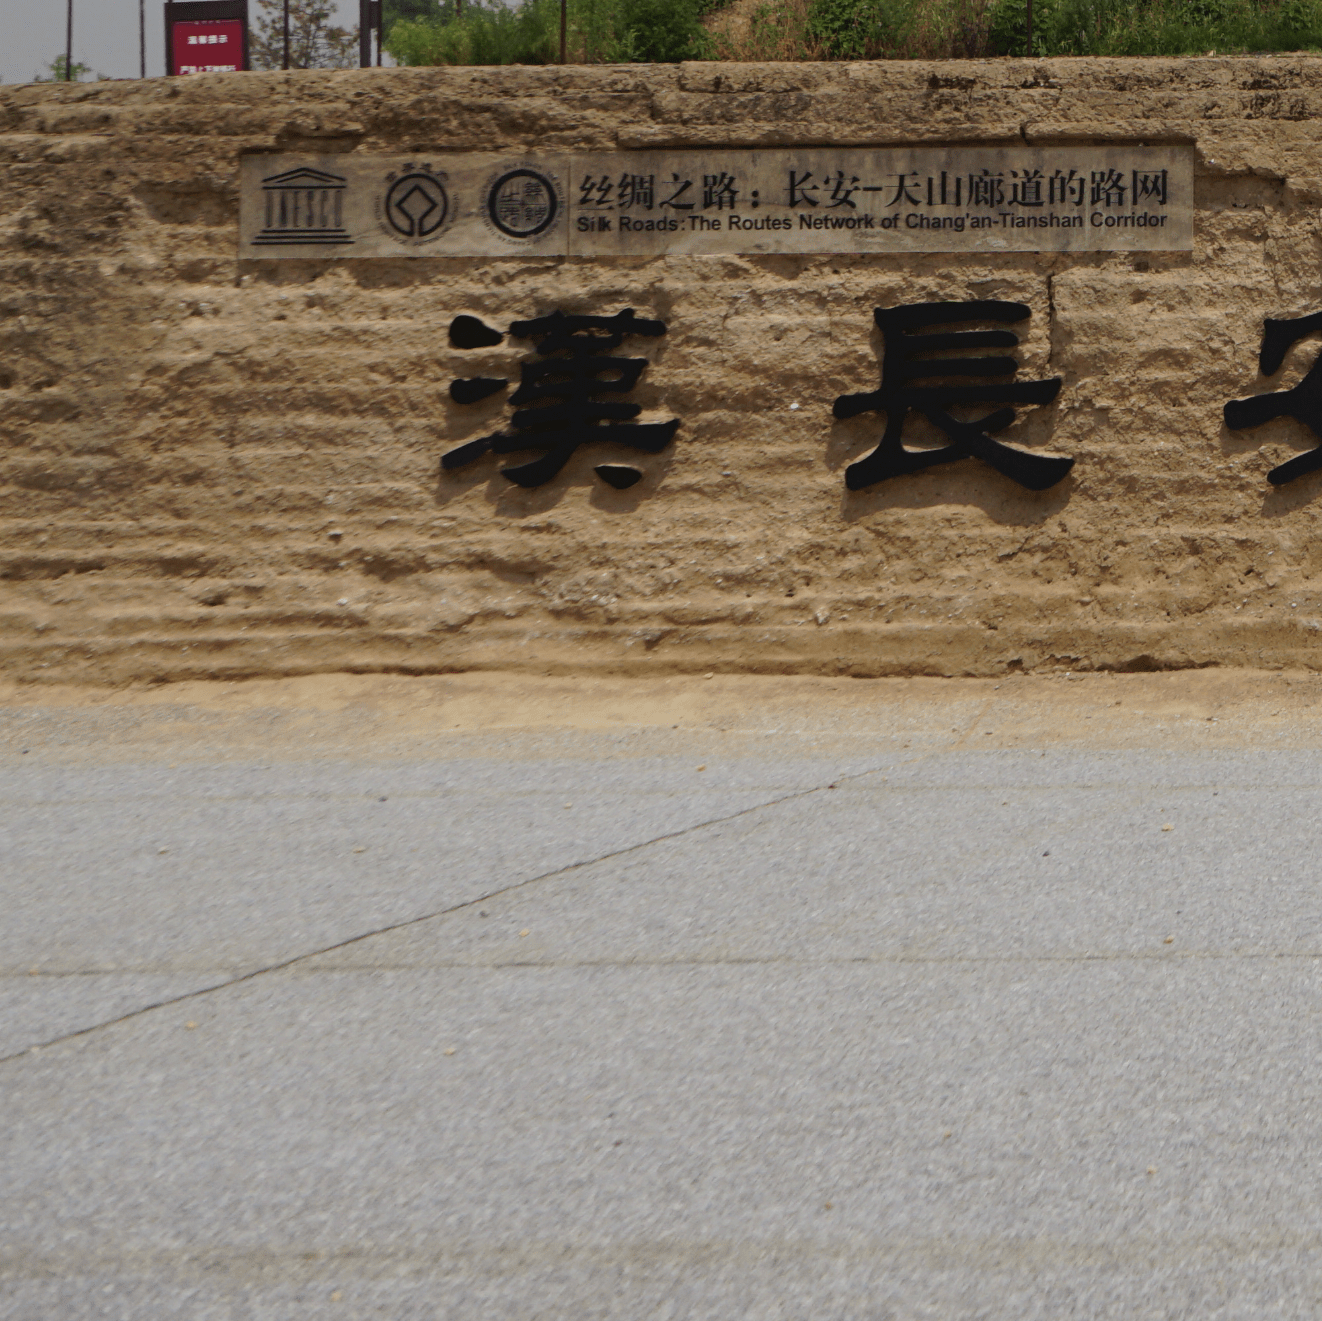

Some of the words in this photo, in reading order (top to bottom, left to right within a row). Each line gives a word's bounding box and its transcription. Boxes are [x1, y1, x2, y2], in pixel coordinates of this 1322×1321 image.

[577, 216, 611, 232] Silk
[728, 214, 792, 231] Routes
[799, 213, 874, 230] Network
[881, 213, 900, 229] of
[905, 212, 1083, 233] Chang'an-Tianshan
[1090, 211, 1168, 228] Corridor
